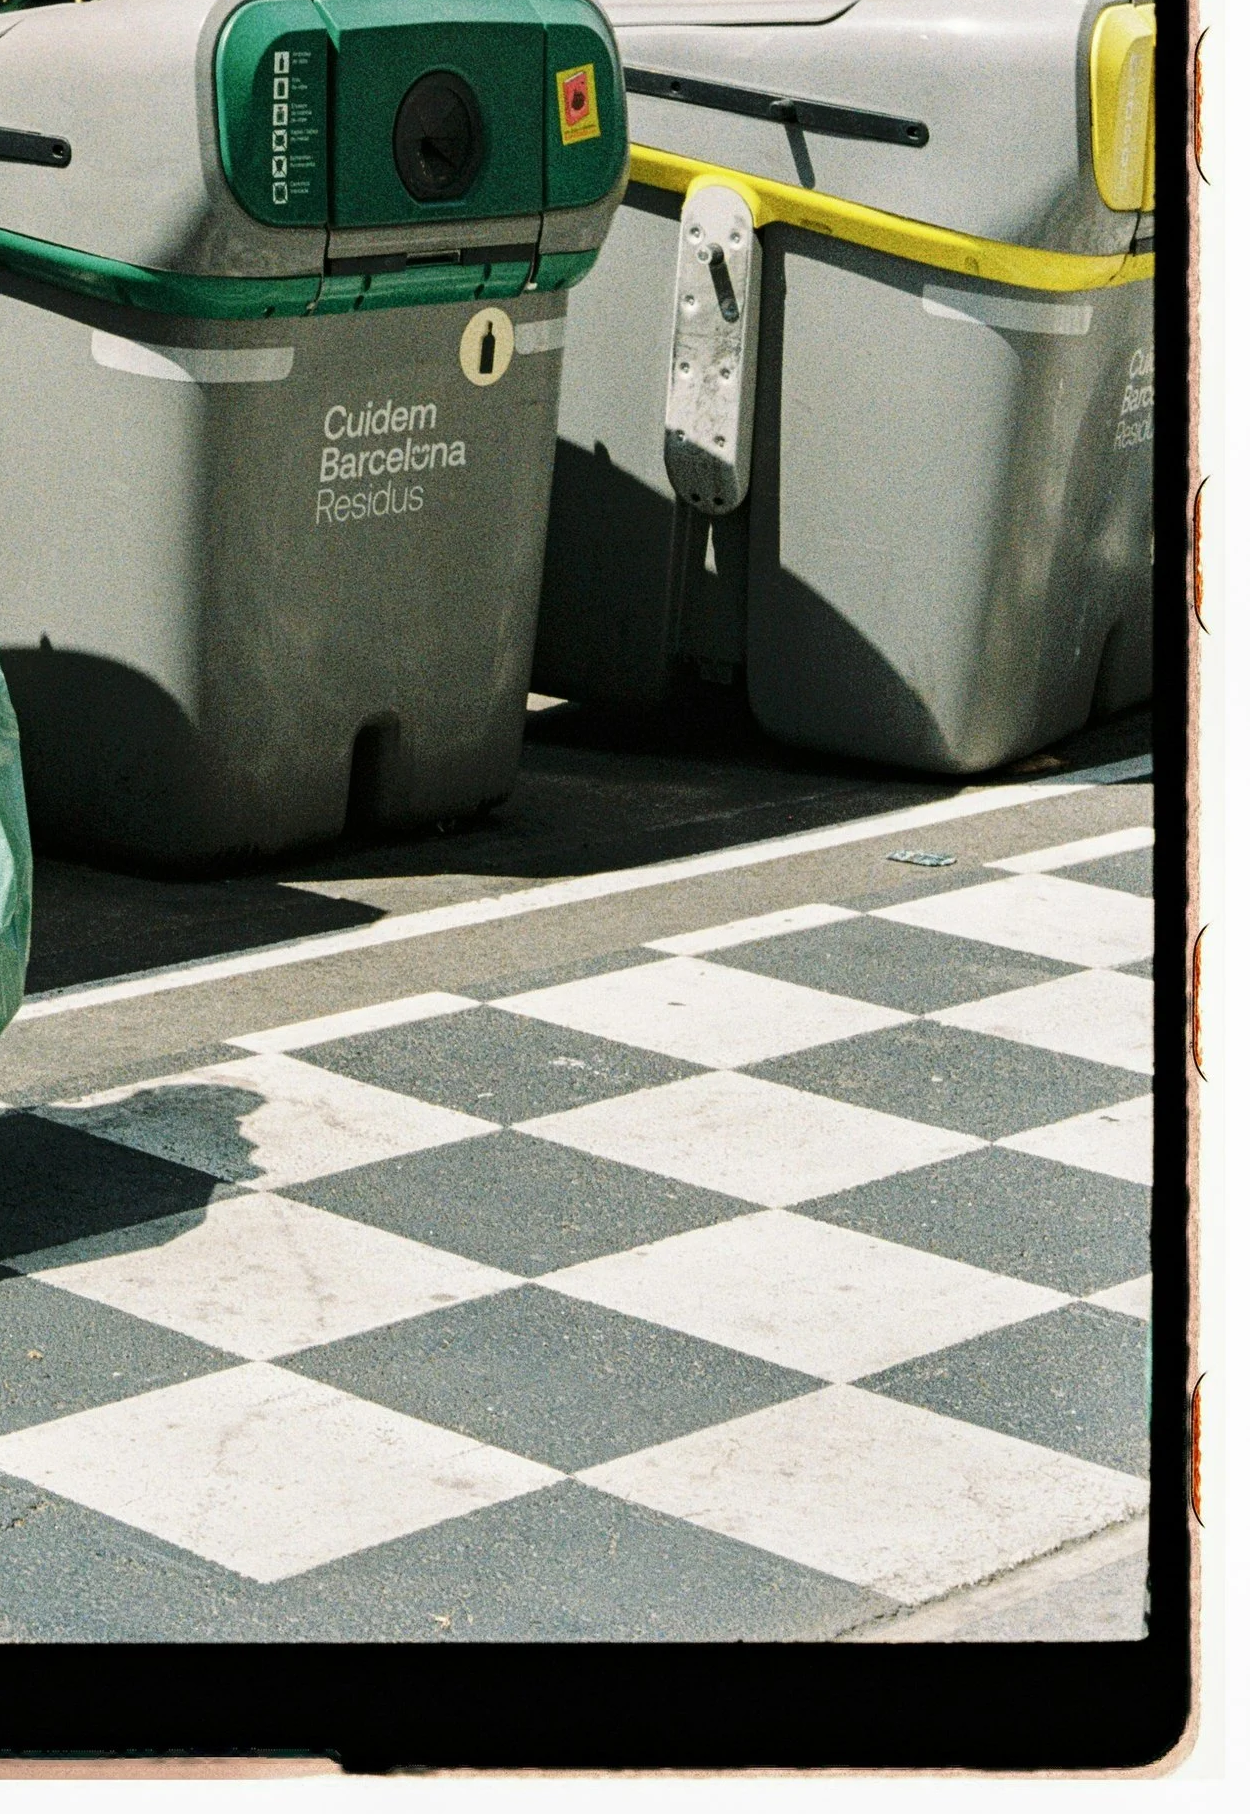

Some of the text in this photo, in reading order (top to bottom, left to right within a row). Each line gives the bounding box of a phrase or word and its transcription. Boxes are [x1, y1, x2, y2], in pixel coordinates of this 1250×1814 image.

[324, 399, 437, 440] Cuidem
[320, 437, 466, 482] Barcelona
[316, 480, 424, 524] Residus
